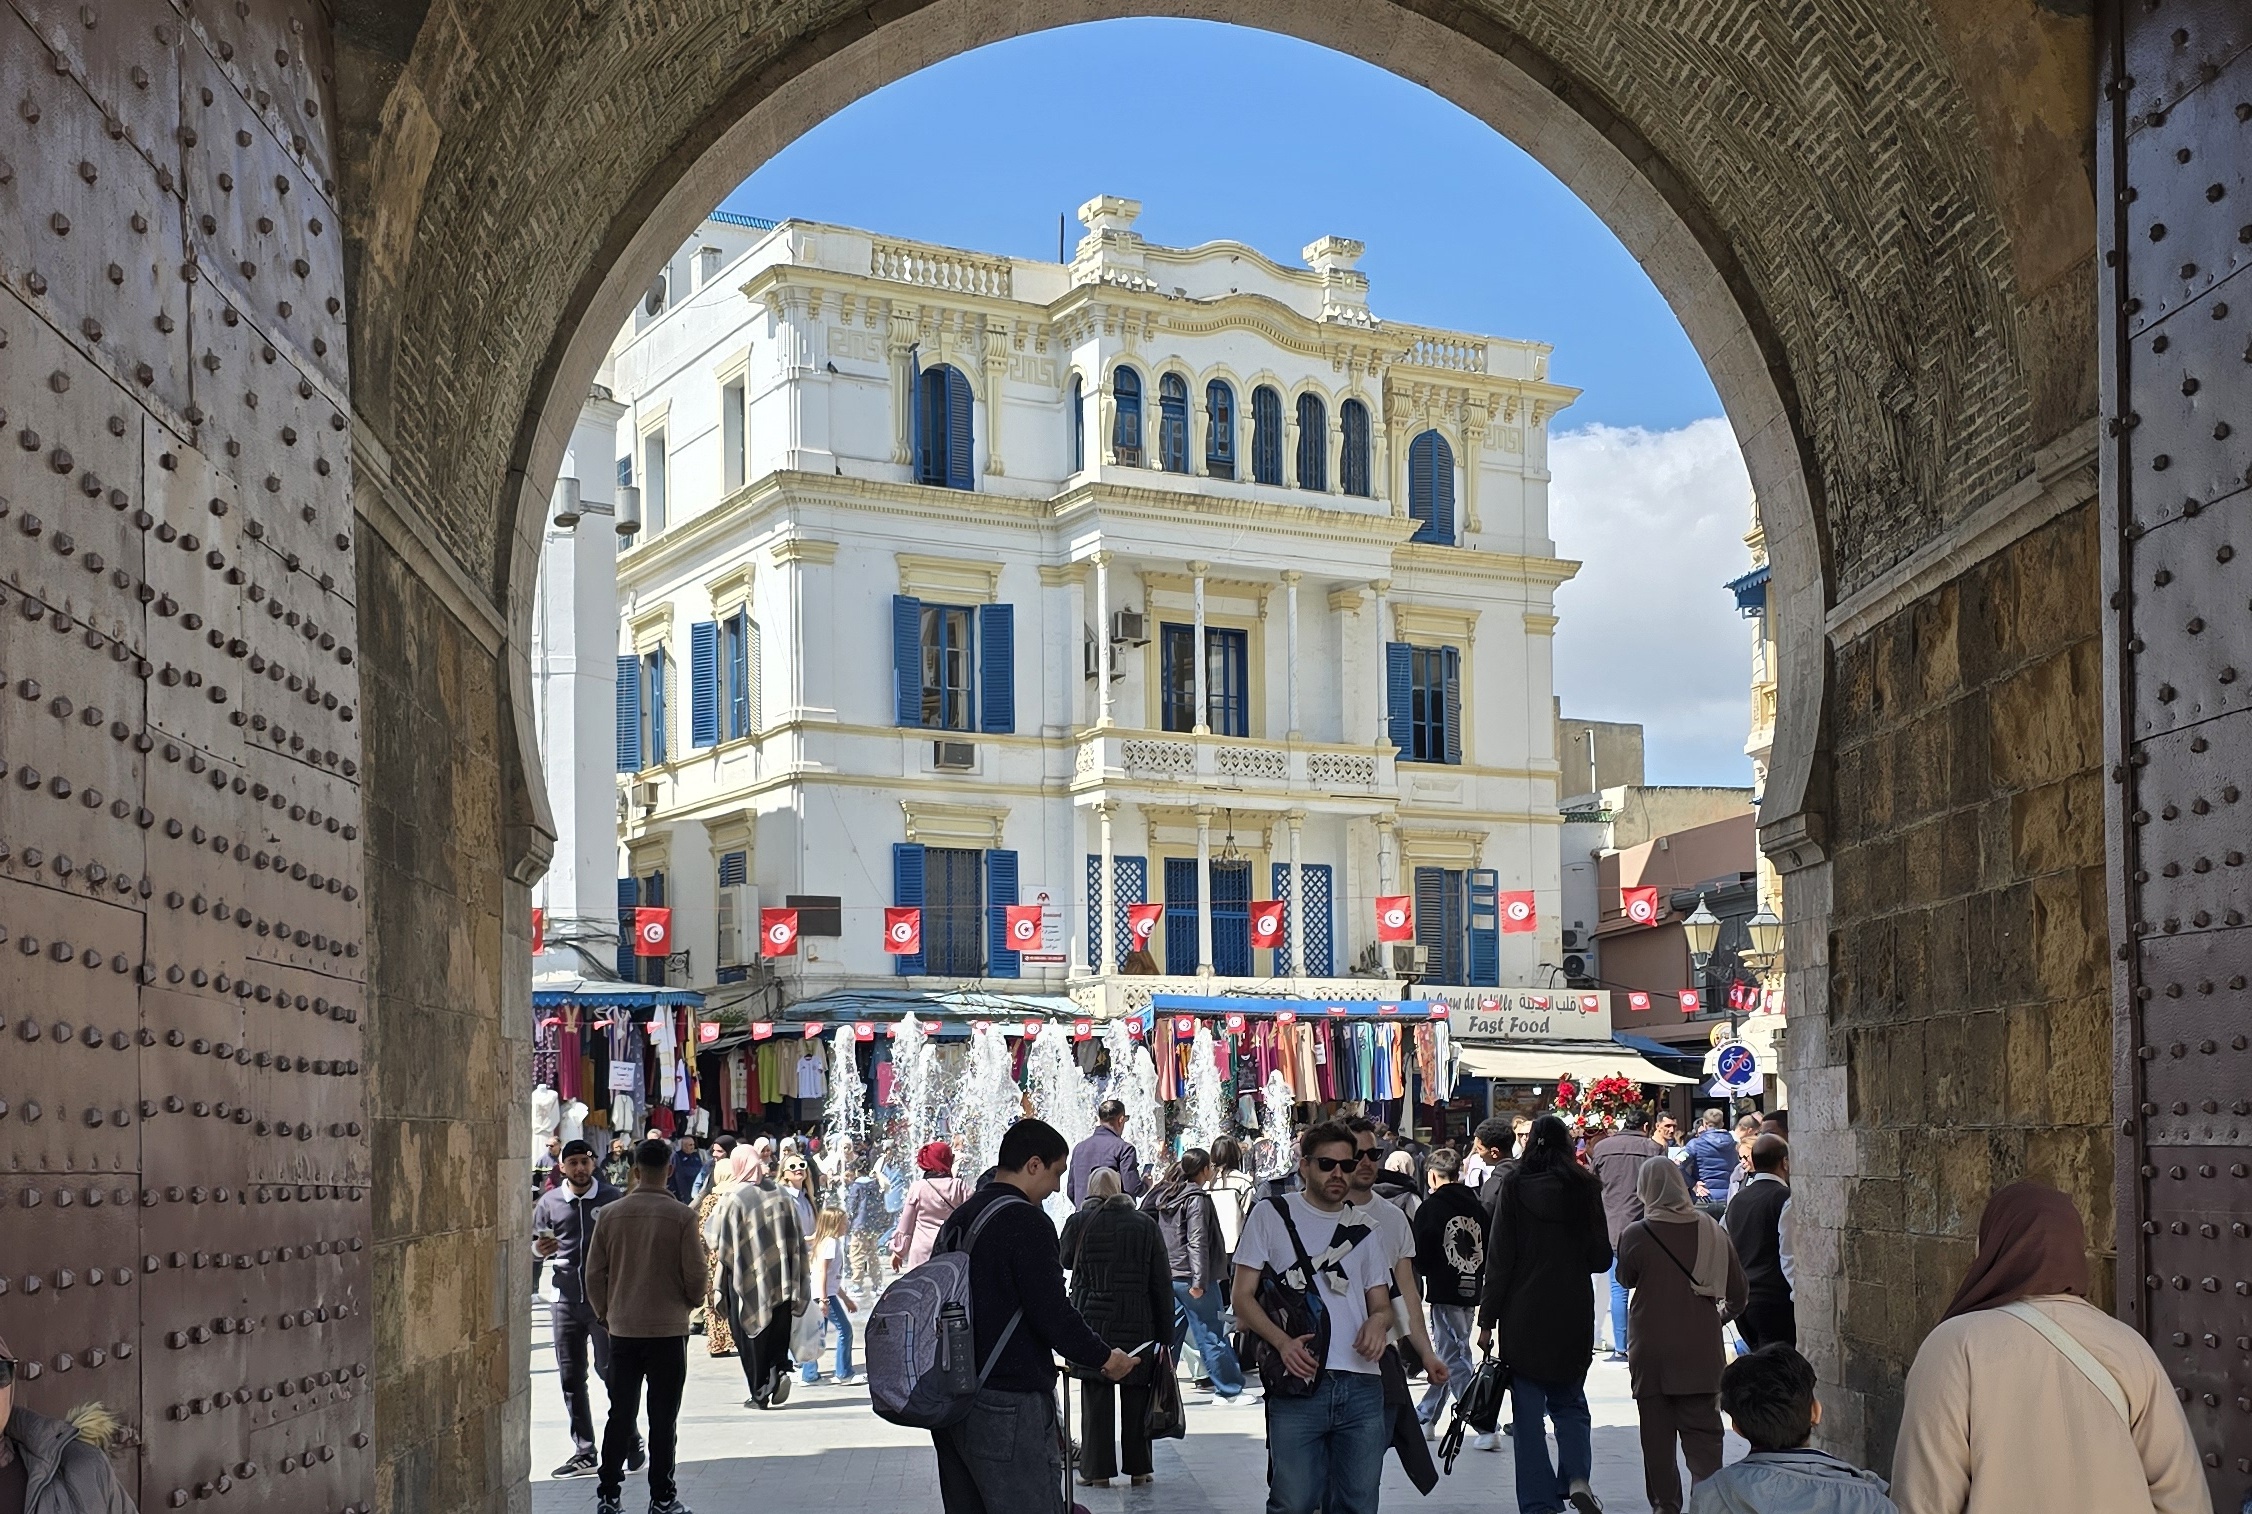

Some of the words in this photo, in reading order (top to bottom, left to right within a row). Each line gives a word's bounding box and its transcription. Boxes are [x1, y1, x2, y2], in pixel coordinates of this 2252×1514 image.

[1464, 991, 1475, 1011] de
[1555, 995, 1577, 1015] قلب
[1468, 1015, 1504, 1034] Fast
[1509, 1016, 1550, 1034] Food
